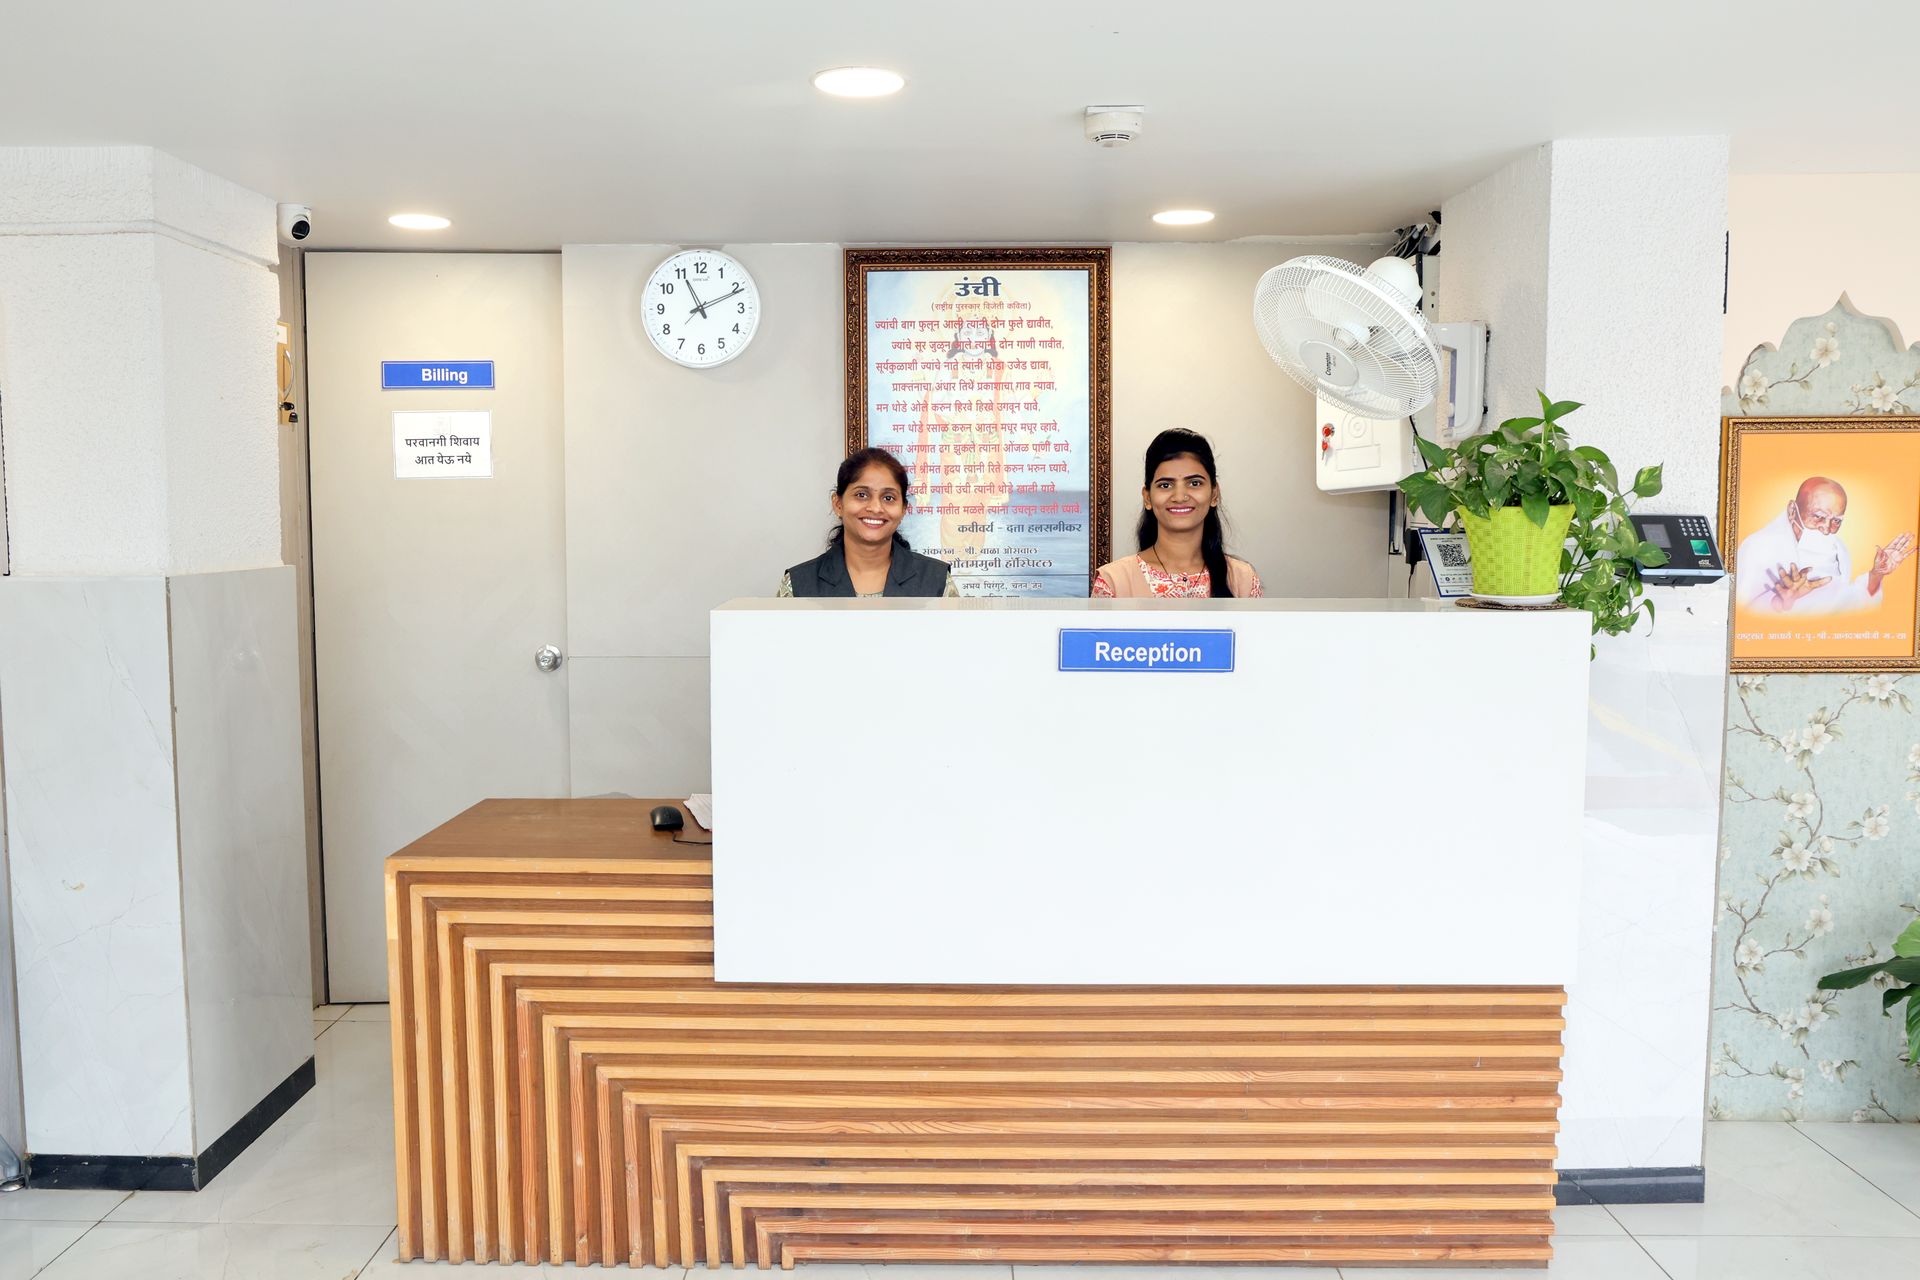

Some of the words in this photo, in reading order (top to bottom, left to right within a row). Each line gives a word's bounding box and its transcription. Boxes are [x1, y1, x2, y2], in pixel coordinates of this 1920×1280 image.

[675, 268, 686, 279] 11
[694, 262, 707, 274] 12
[718, 267, 723, 279] 1
[660, 283, 674, 294] 10
[732, 282, 740, 293] 2
[955, 276, 1001, 296] उंची
[657, 303, 665, 315] 9
[737, 302, 745, 314] 3
[663, 323, 671, 335] 8
[732, 323, 740, 334] 4
[875, 317, 898, 330] ज्यांची
[918, 320, 940, 332] फुलून
[966, 316, 988, 329] त्यांनी
[990, 316, 1005, 328] दोन
[1008, 316, 1023, 331] फुले
[677, 338, 685, 350] 7
[698, 343, 705, 355] 6
[718, 337, 725, 349] 5
[892, 338, 912, 350] ज्यांचे
[914, 341, 926, 352] सूर
[929, 341, 950, 352] जुळून
[999, 338, 1014, 350] दोन
[1016, 337, 1036, 350] गाणी
[875, 358, 917, 374] सूर्यकुळाशी
[921, 358, 940, 370] ज्यांचे
[944, 359, 959, 370] नाते
[962, 358, 983, 370] त्यांनी
[1008, 358, 1027, 370] उजेड
[421, 368, 468, 384] Billing
[935, 380, 956, 392] अंधार
[977, 382, 1013, 391] प्रकाशाचा
[1016, 382, 1030, 391] गाव
[876, 403, 888, 412] मन
[892, 400, 907, 412] थोडे
[910, 400, 928, 412] ओले
[954, 400, 972, 412] हिरवे
[997, 402, 1020, 414] उगवून
[892, 424, 904, 433] मन
[908, 420, 924, 433] थोडे
[926, 424, 948, 433] रसाळ
[975, 423, 998, 434] आतून
[405, 434, 446, 448] परवानगी
[449, 434, 480, 446] शिवाय
[907, 442, 936, 454] अंगणात
[954, 440, 975, 456] झुकले
[1004, 440, 1029, 453] ओंजळ
[1032, 440, 1050, 452] पाणी
[415, 456, 434, 465] आत
[436, 452, 454, 464] येऊ
[456, 452, 472, 464] नये
[920, 462, 941, 474] श्रीमंत
[944, 464, 960, 476] हृदय
[964, 462, 985, 474] त्यांनी
[988, 461, 1001, 473] रिते
[930, 482, 953, 494] ज्यांची
[956, 482, 971, 494] उंची
[974, 482, 995, 494] त्यांनी
[916, 506, 933, 515] जन्म
[936, 502, 960, 515] मातीत
[963, 502, 984, 515] मळले
[958, 521, 994, 533] कवीवर्य
[1006, 524, 1024, 534] दत्ता
[1027, 520, 1081, 534] हलसगीकर
[1095, 641, 1202, 667] Reception
